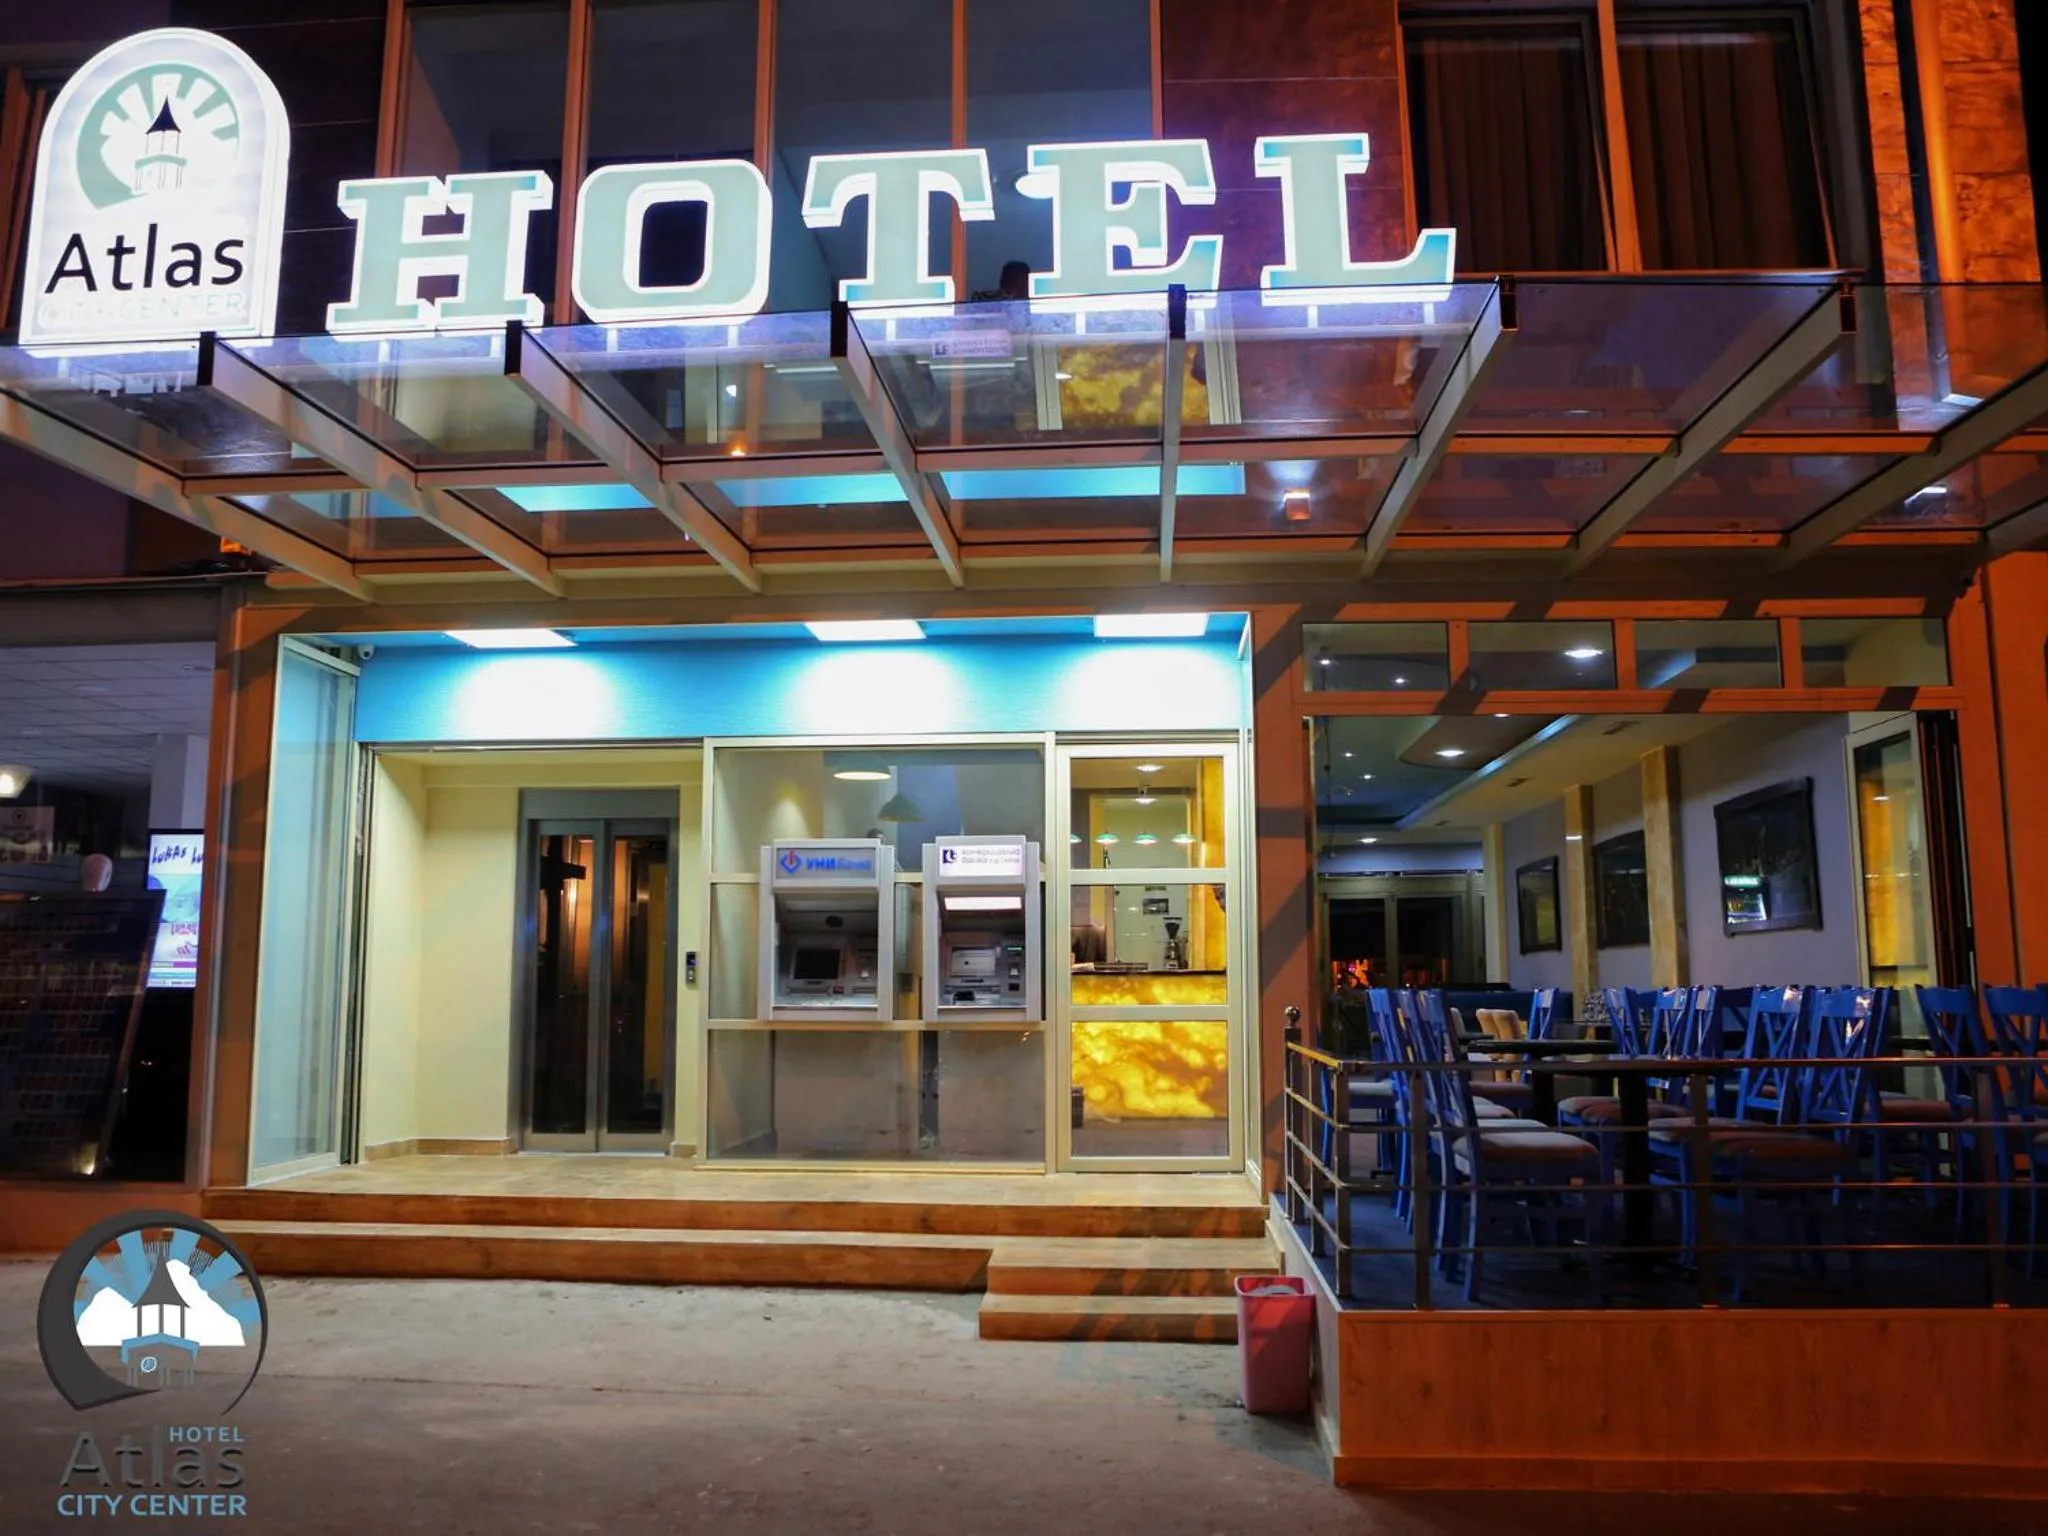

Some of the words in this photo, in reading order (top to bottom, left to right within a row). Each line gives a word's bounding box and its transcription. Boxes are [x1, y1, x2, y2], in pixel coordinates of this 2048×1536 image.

[44, 222, 244, 294] Atlas
[324, 131, 1458, 334] HOTEL
[119, 292, 244, 320] CENTER
